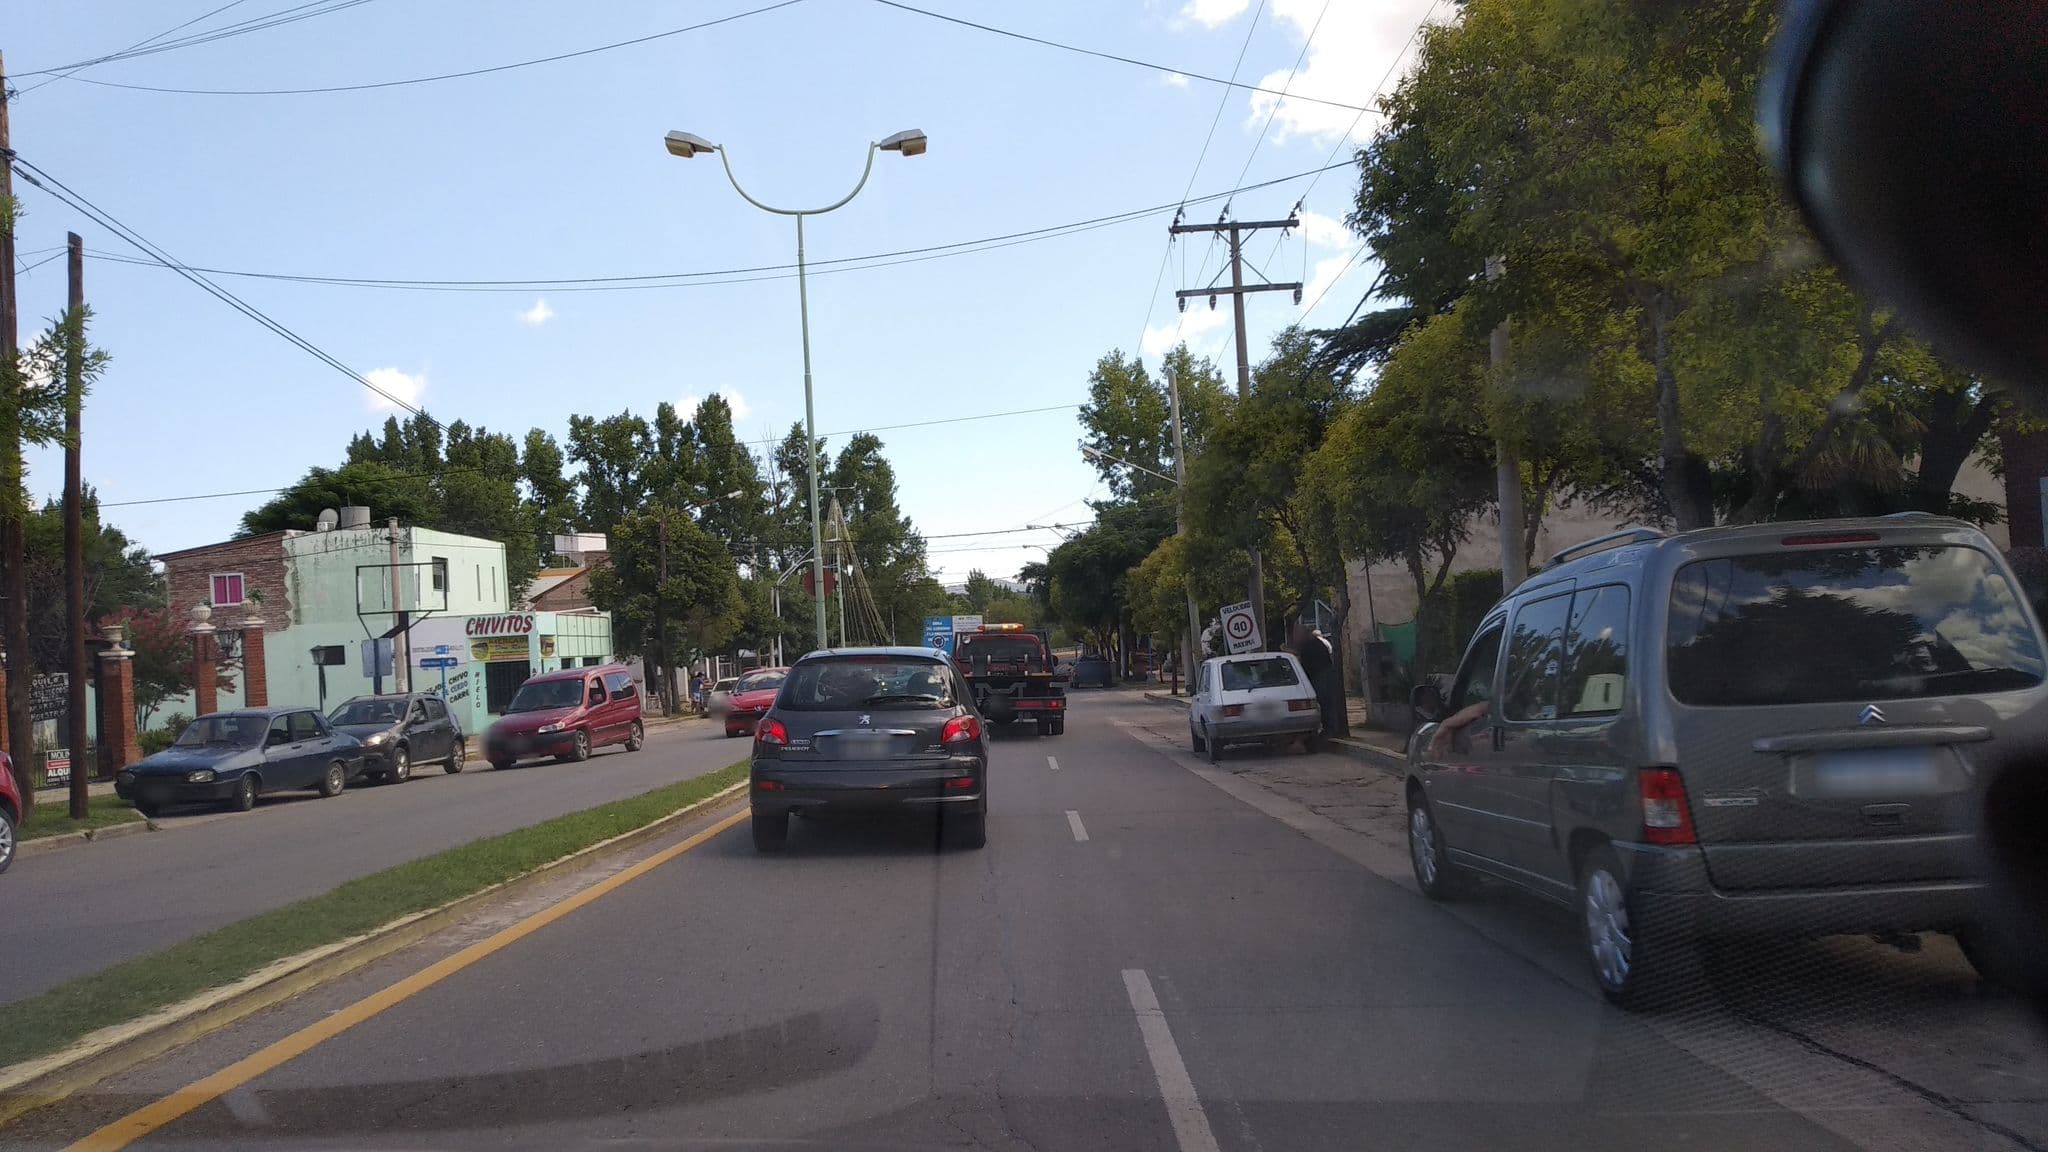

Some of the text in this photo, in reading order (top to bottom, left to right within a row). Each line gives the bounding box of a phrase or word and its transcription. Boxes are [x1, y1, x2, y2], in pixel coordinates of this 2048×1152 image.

[1222, 602, 1251, 614] VELOCIDAD
[466, 615, 533, 636] CHIVITOS
[1234, 621, 1248, 633] 40
[448, 671, 468, 685] CHIVO
